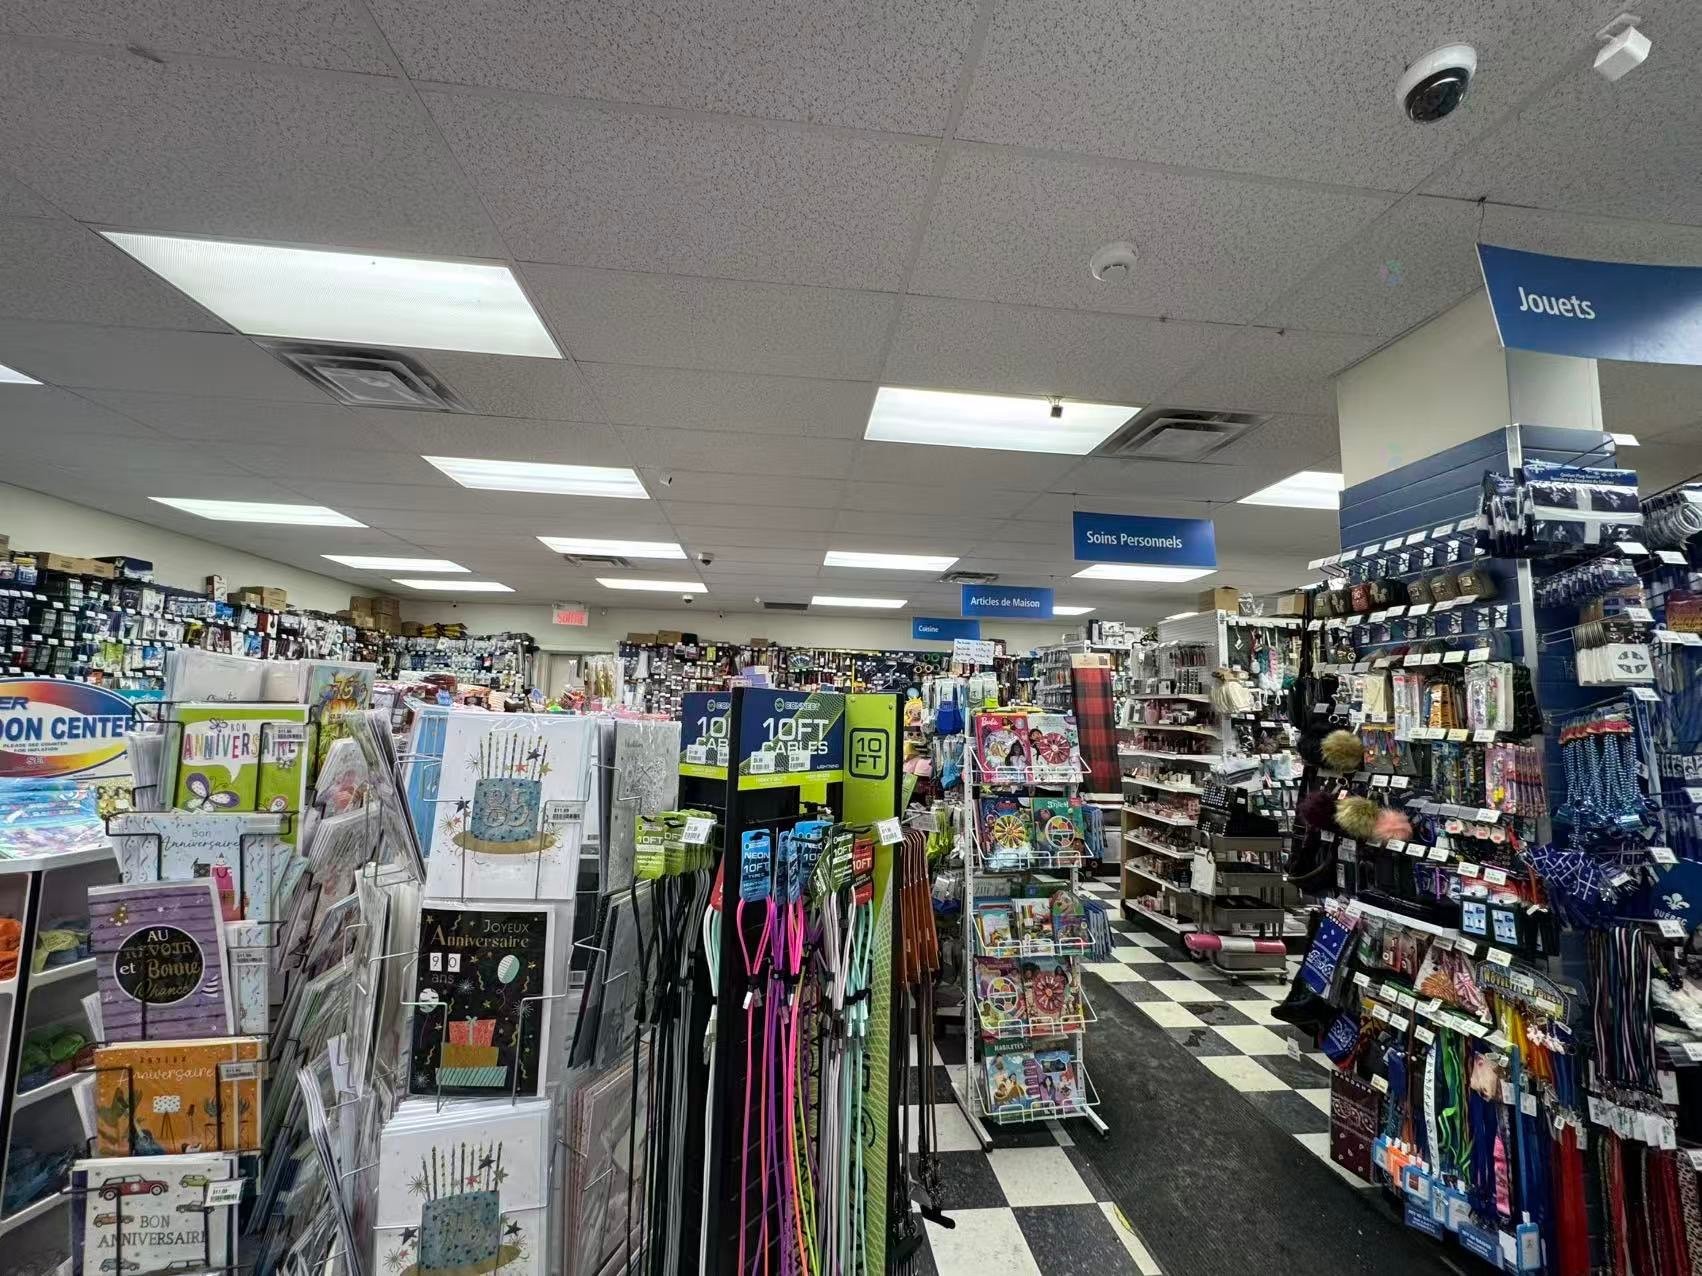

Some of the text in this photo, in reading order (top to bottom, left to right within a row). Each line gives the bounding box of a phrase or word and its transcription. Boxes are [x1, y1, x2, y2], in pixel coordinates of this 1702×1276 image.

[1518, 286, 1596, 320] Jouets
[1086, 530, 1183, 549] Soins Personnels
[970, 596, 1040, 609] Articles de Maison
[918, 624, 939, 634] Cuisine
[0, 716, 136, 741] ON CENTER
[231, 722, 246, 732] BON
[697, 716, 731, 738] 10
[762, 717, 829, 741] 10FT
[762, 741, 828, 755] CABLES
[857, 737, 882, 753] 10
[856, 755, 882, 770] FT
[191, 829, 211, 838] Bon
[637, 836, 663, 844] 10FT
[159, 836, 240, 851] Anniversaire
[833, 844, 852, 856] 10FT
[744, 851, 769, 859] NEON
[743, 862, 770, 873] 10FT
[852, 857, 872, 870] 10FT
[147, 929, 169, 943] AU
[430, 924, 529, 948] Anniversaire
[119, 959, 201, 979] et Bonne
[432, 973, 455, 984] ans
[133, 981, 193, 1001] Chance
[140, 1215, 171, 1229] BON
